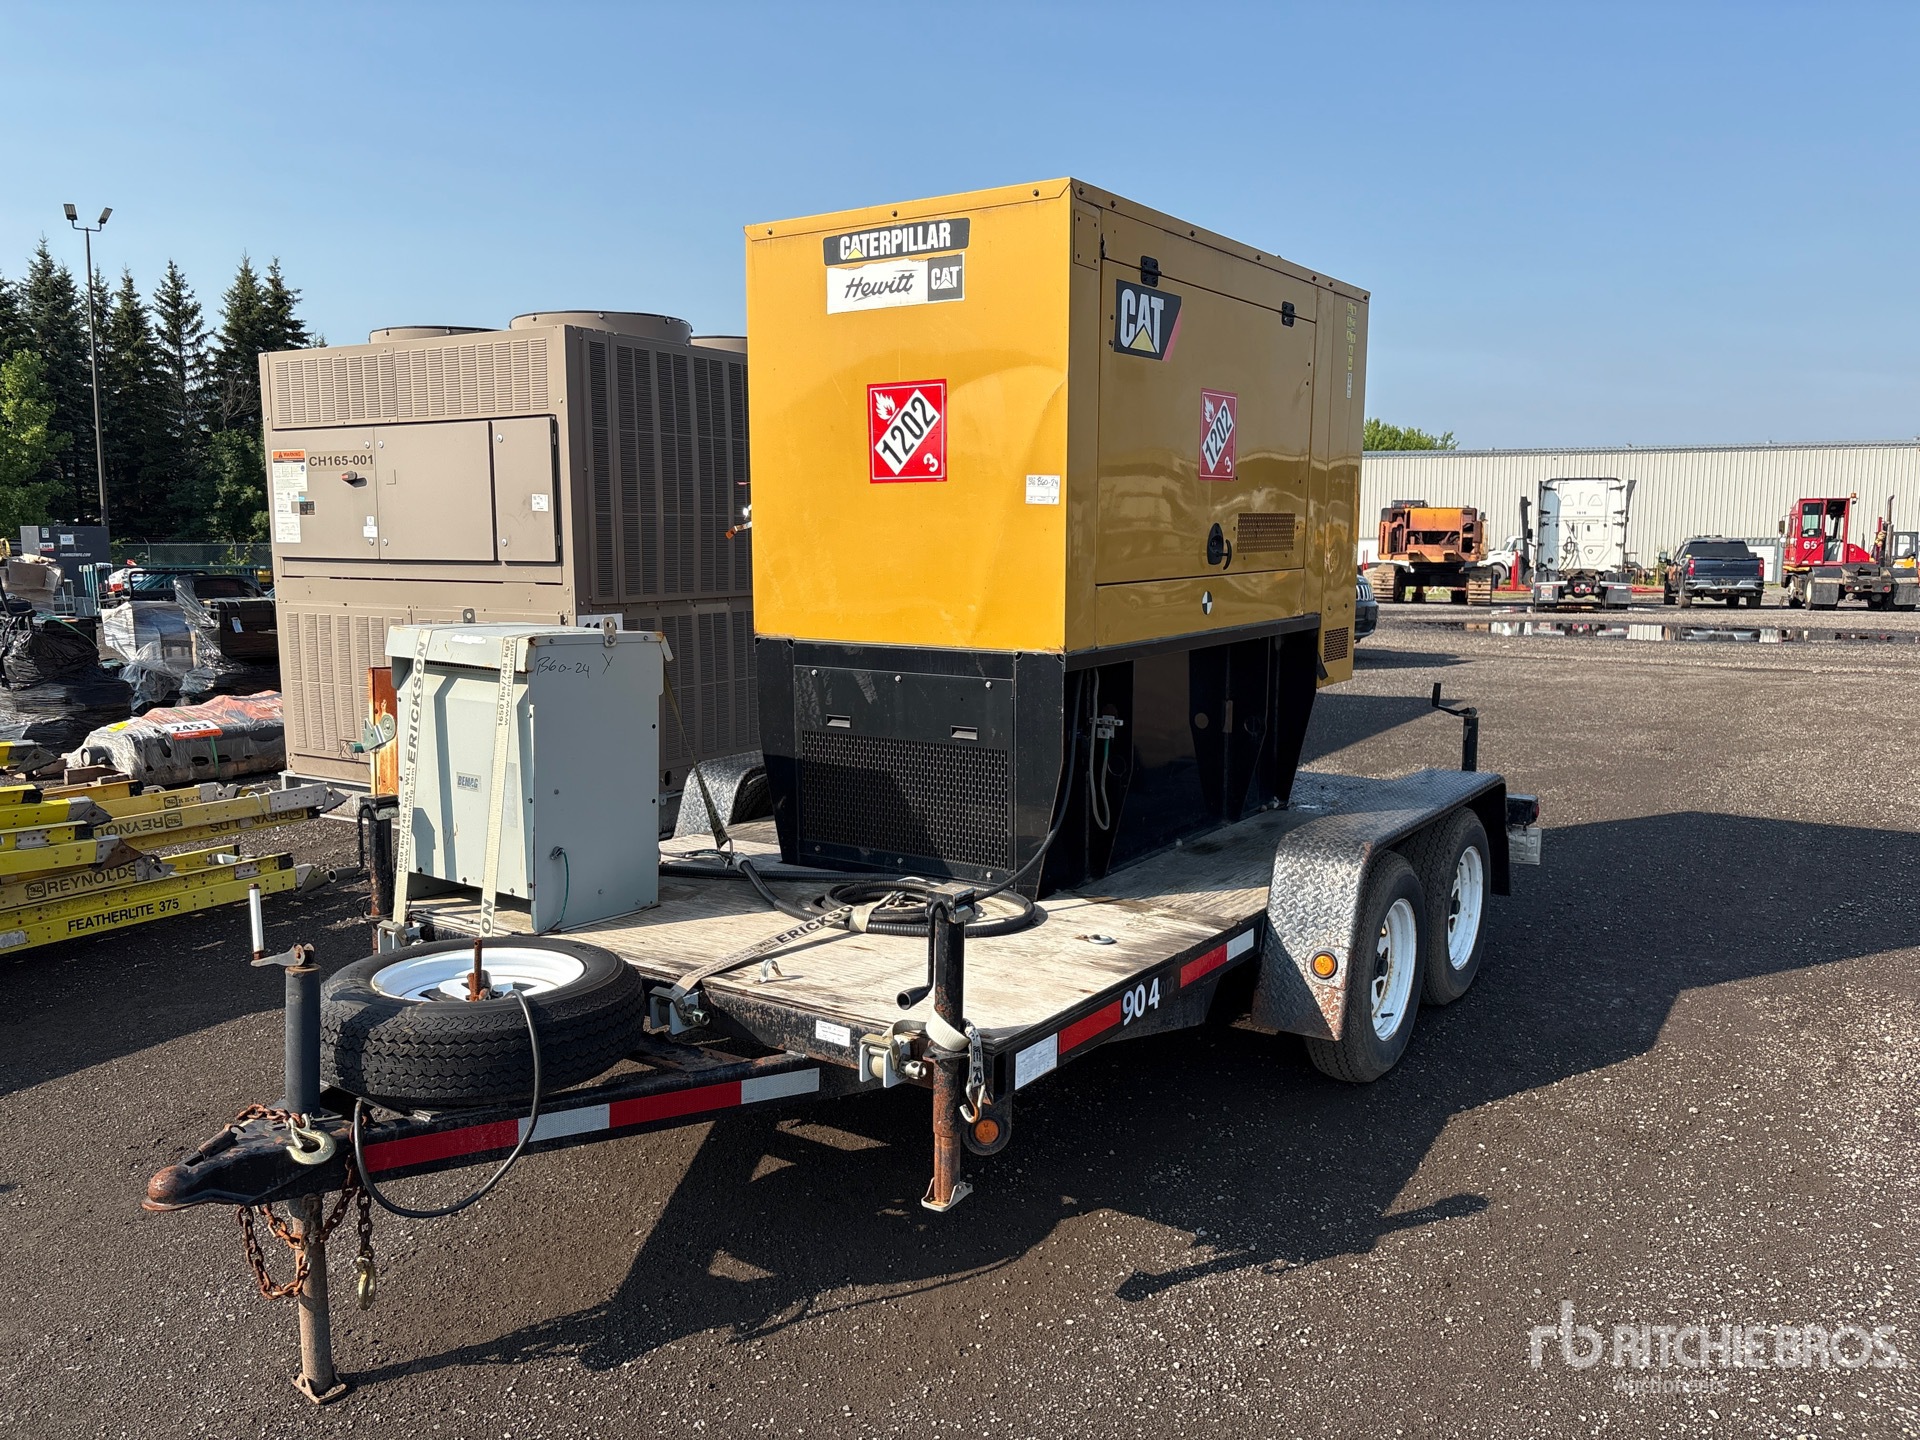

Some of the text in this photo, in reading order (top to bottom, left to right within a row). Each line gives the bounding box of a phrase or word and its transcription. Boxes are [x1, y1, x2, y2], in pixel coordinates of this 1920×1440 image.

[839, 222, 951, 260] CATERPILLAR
[844, 271, 915, 300] Hewitt
[930, 266, 960, 290] CAT
[1120, 288, 1165, 354] CAT
[881, 396, 936, 466] 1202
[1205, 405, 1232, 466] 1202
[308, 454, 374, 467] CH165-001
[923, 452, 939, 473] 3
[1224, 455, 1233, 474] 3
[1803, 540, 1818, 550] 65
[536, 656, 590, 679] B60-24
[407, 641, 427, 765] ERICKSON
[93, 816, 164, 836] REYNOL
[46, 865, 137, 895] REYNOLDS
[67, 898, 180, 933] FEATHERLITE 375
[775, 906, 854, 944] ERICKSO
[1122, 977, 1160, 1026] 904
